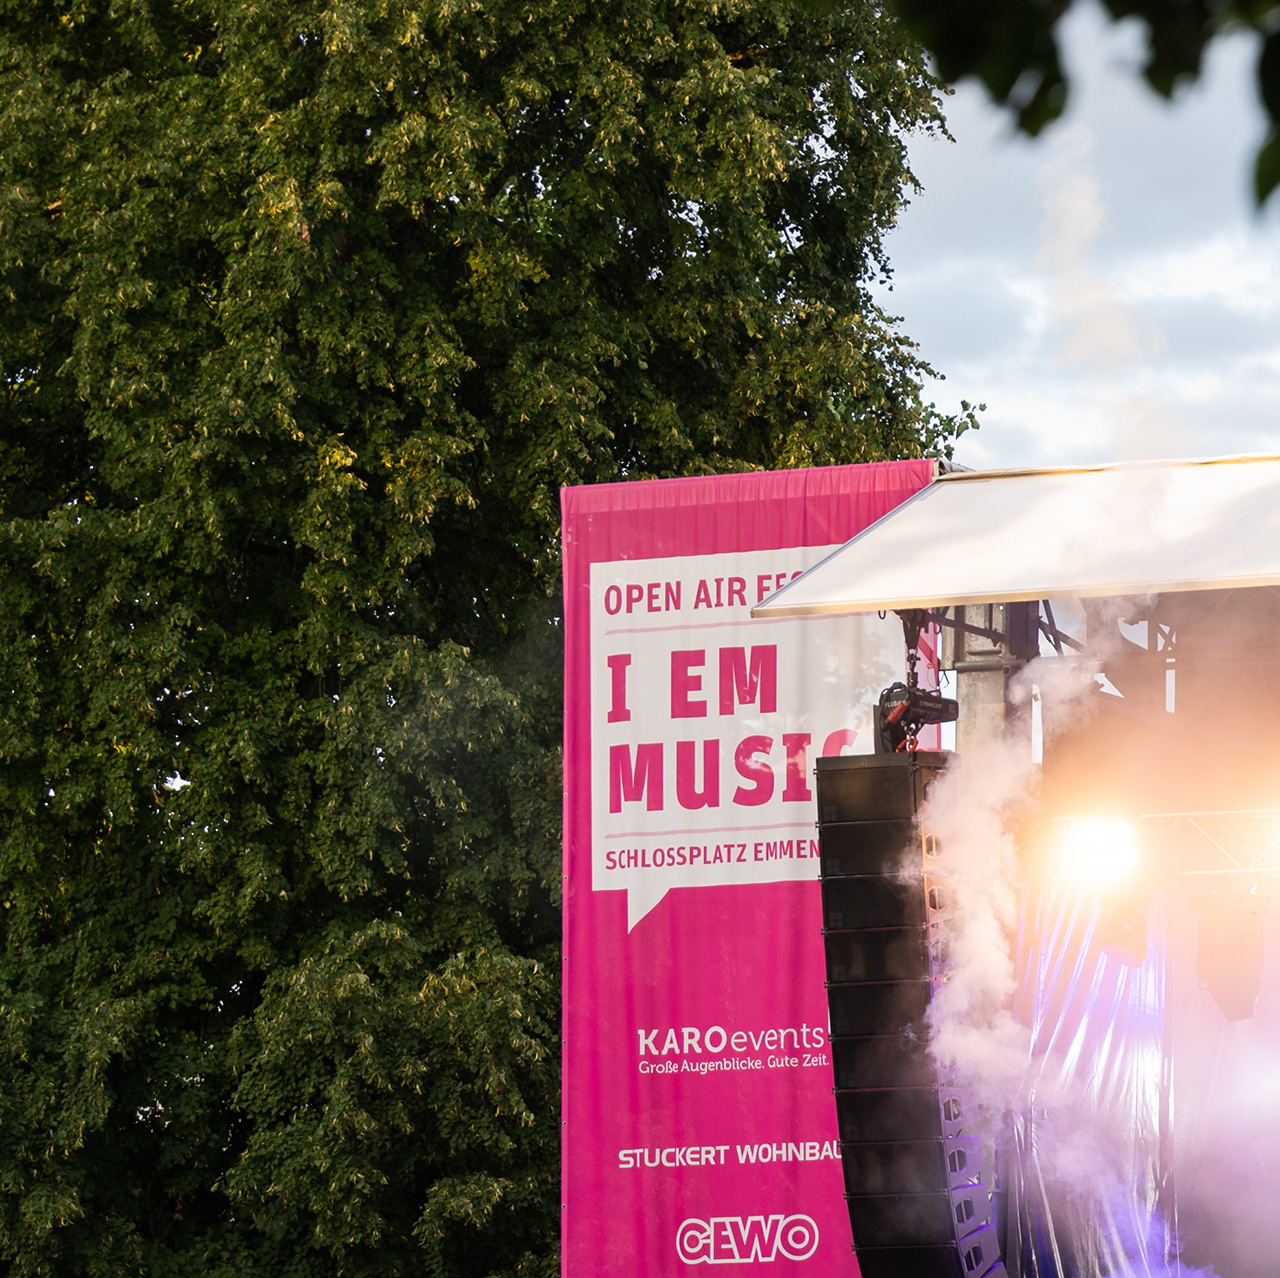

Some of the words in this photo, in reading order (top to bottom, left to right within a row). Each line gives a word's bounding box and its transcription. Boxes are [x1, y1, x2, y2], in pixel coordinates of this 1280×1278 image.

[605, 581, 681, 616] OPEN
[693, 576, 747, 610] AIR
[607, 654, 632, 724] I
[671, 644, 778, 719] EM
[605, 843, 747, 870] SCHLOSSPLATZ
[637, 1023, 825, 1055] KAROevents
[638, 1061, 679, 1074] Große
[680, 1056, 765, 1075] Augenblicke.
[767, 1054, 799, 1068] Gute
[802, 1053, 829, 1067] Zeit.
[618, 1145, 730, 1168] STUCKERT
